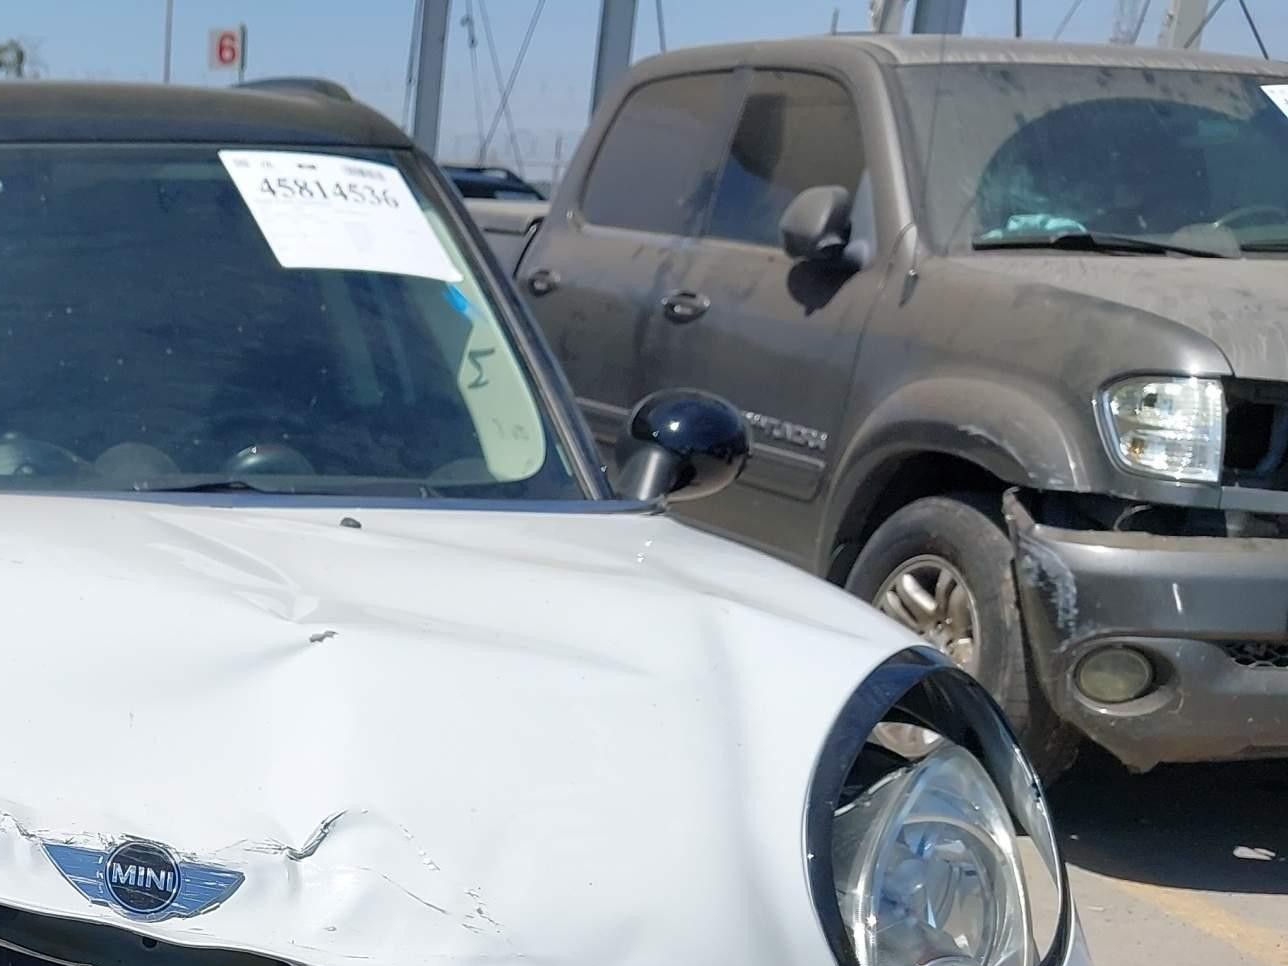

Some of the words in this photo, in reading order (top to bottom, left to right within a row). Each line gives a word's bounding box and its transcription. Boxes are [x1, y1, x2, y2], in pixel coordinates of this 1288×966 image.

[218, 34, 236, 64] 6
[260, 177, 400, 209] 45814536
[111, 862, 174, 892] MINI
